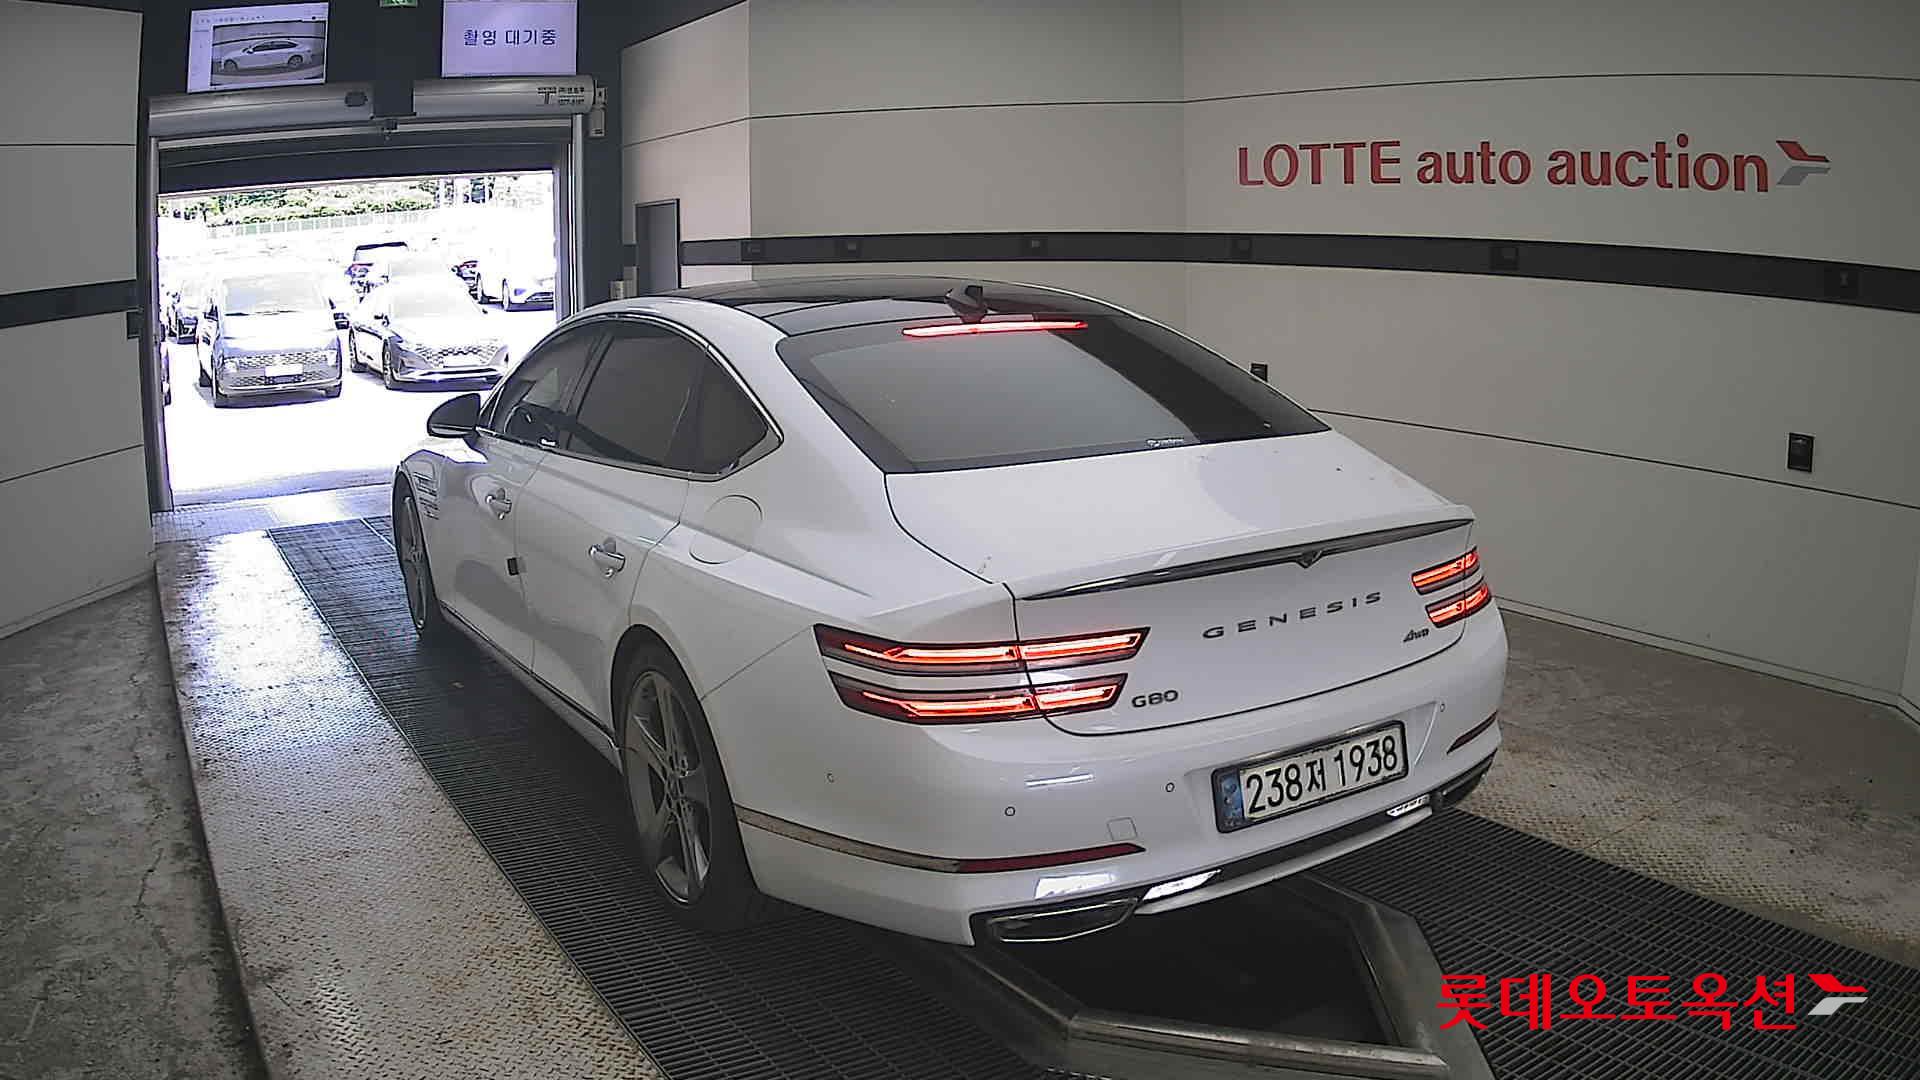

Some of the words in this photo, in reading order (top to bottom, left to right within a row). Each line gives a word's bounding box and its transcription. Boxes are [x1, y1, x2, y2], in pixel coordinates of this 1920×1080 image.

[463, 29, 497, 46] 촬영
[505, 29, 557, 46] 대기중
[1238, 140, 1401, 187] LOTTE
[1417, 141, 1532, 185] auto
[1546, 133, 1770, 193] auction
[1202, 591, 1382, 639] GENESIS
[1131, 689, 1179, 708] G80
[1246, 757, 1327, 814] 238저
[1333, 735, 1398, 787] 1938
